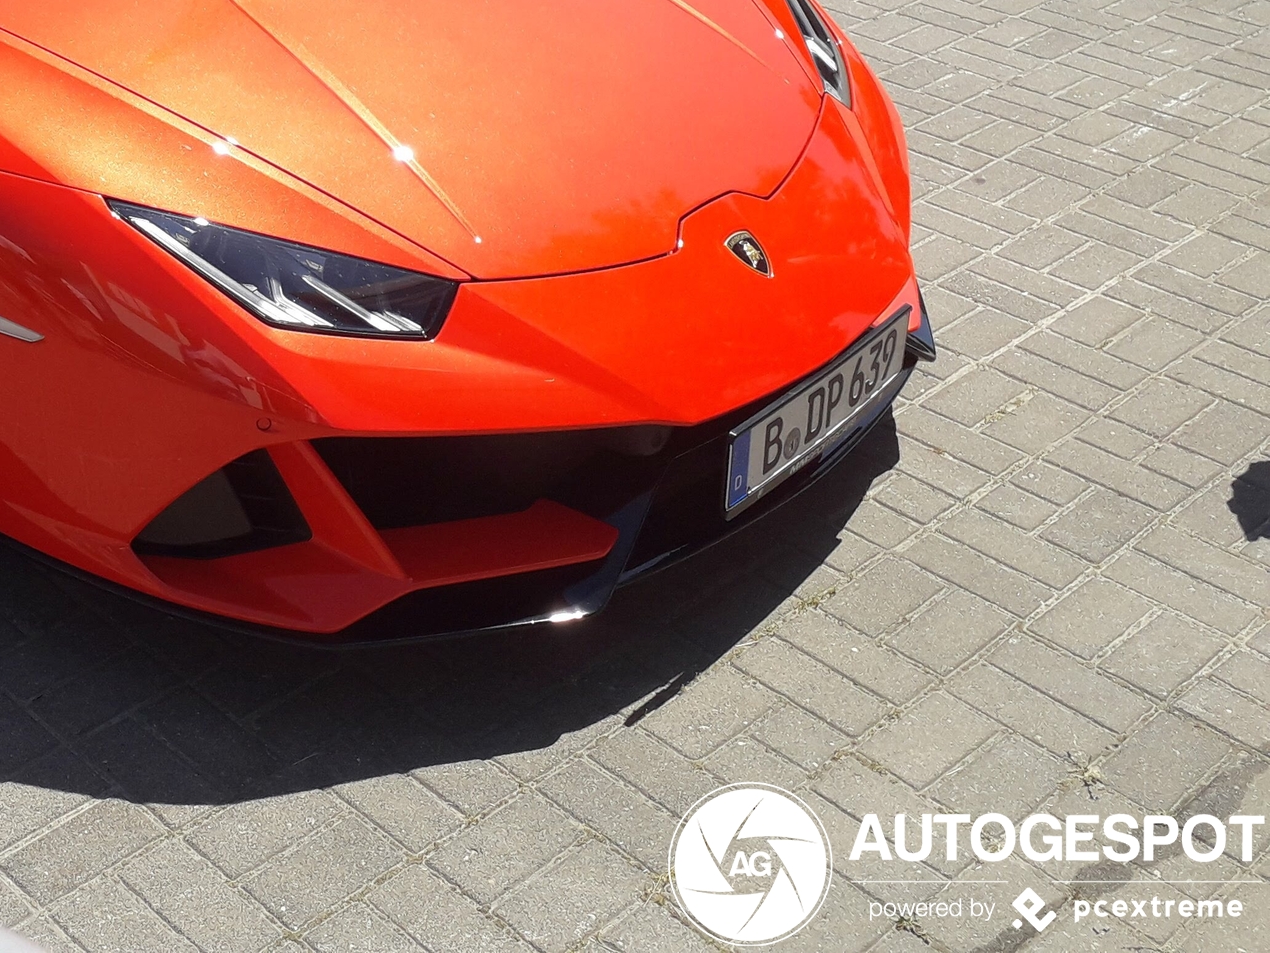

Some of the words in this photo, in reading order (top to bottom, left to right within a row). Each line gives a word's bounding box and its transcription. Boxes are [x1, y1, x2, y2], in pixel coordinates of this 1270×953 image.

[763, 417, 783, 475] B
[805, 373, 844, 444] DP
[848, 329, 897, 408] 639
[734, 474, 742, 491] D
